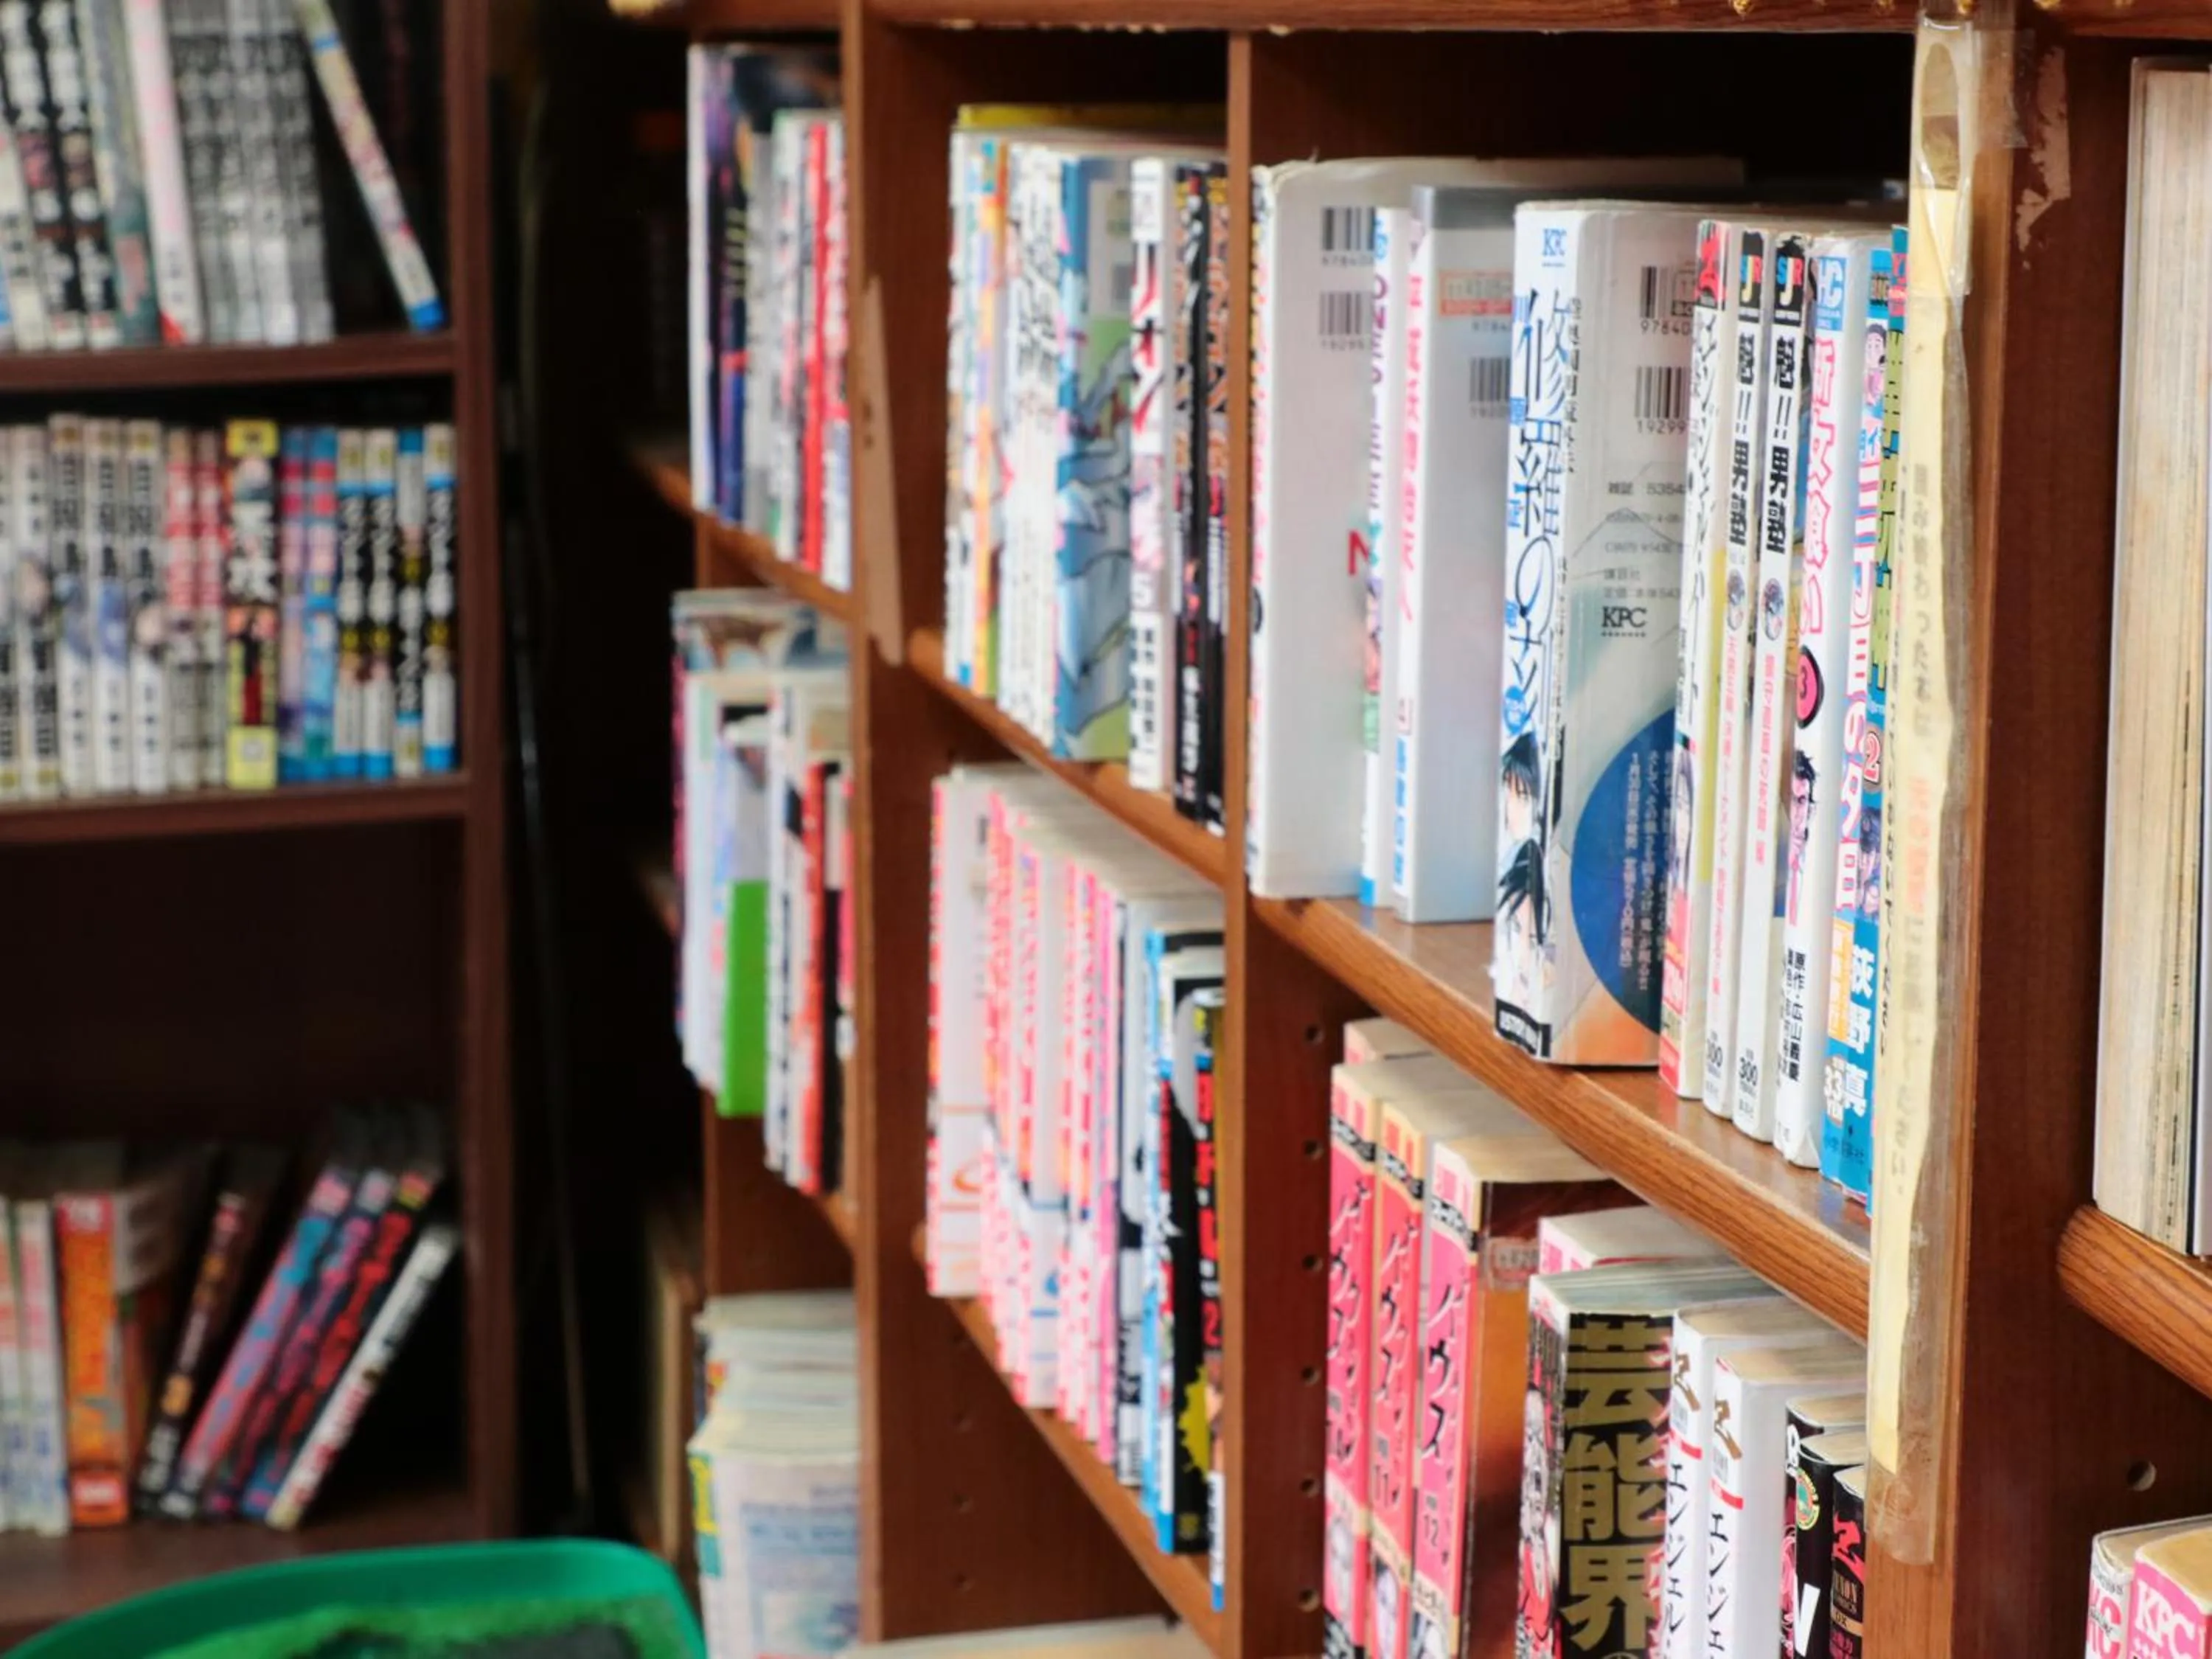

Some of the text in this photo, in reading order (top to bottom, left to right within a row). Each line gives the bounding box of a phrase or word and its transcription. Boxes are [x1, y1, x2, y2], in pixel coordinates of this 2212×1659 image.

[1601, 605, 1647, 628] KPC
[1863, 731, 1881, 785] 2
[1738, 1056, 1759, 1087] 300
[1559, 1318, 1671, 1651] 芸能界
[1664, 1464, 1689, 1659] エンジェル・
[1707, 1512, 1731, 1659] エンジェ
